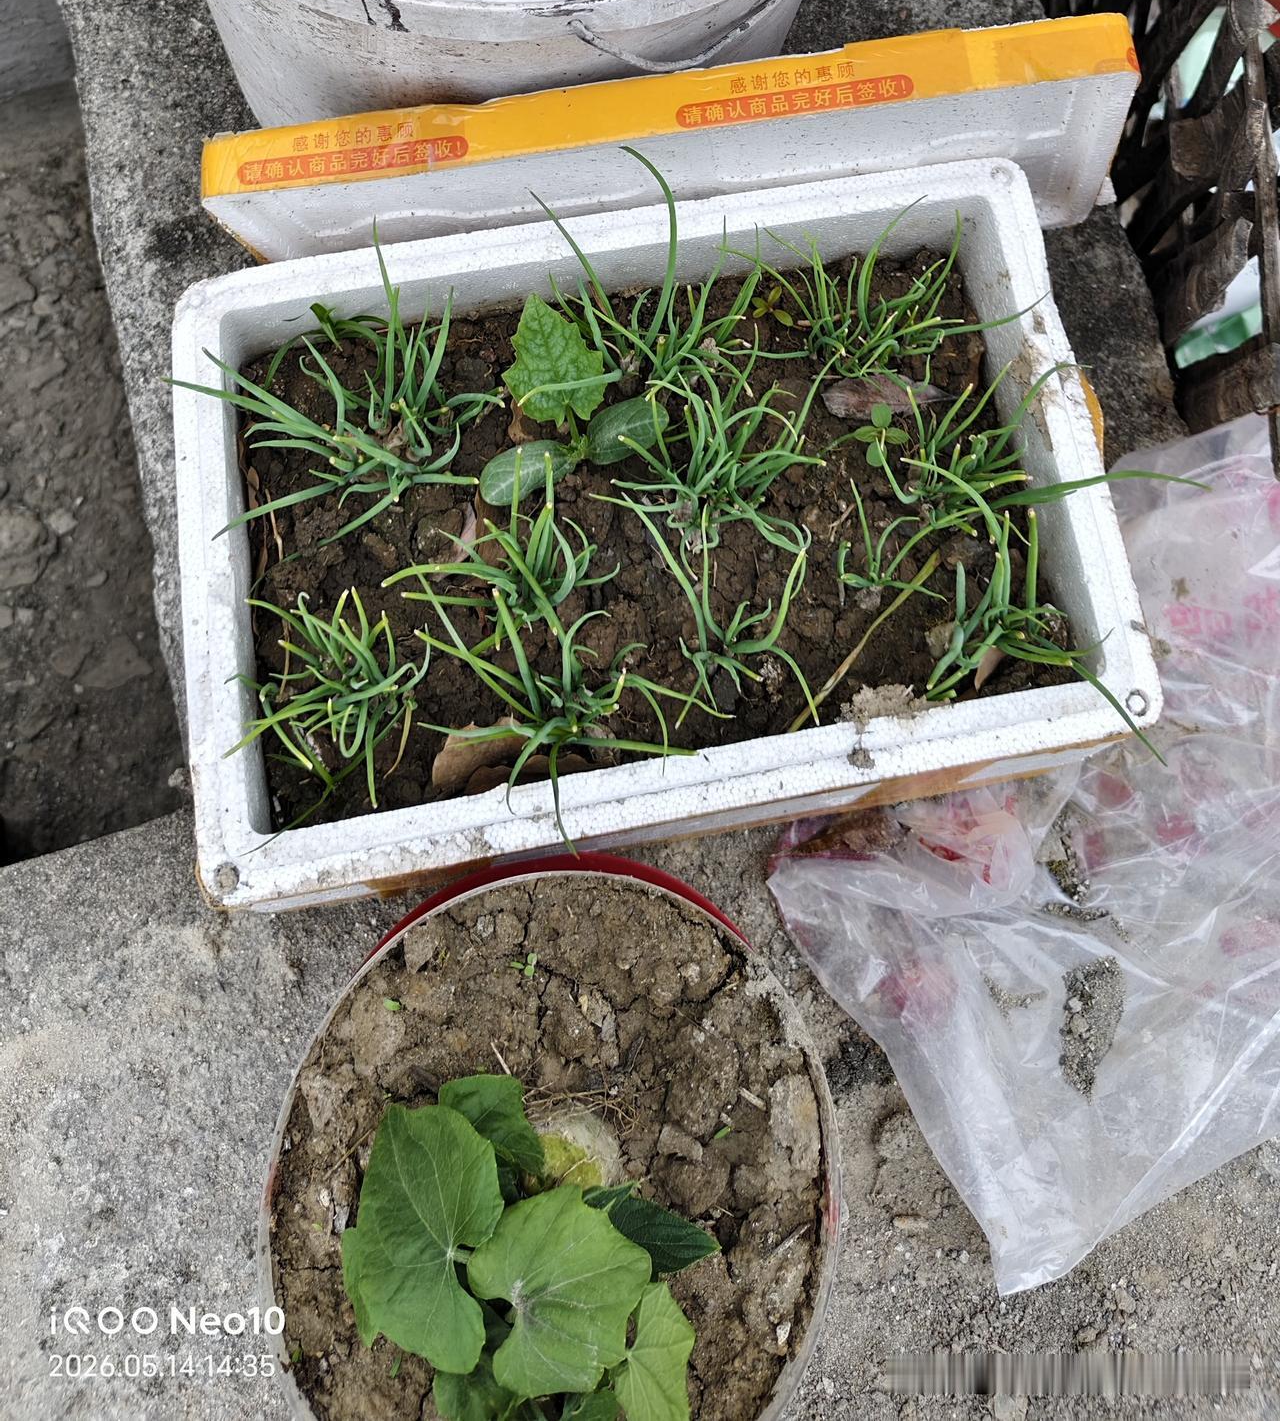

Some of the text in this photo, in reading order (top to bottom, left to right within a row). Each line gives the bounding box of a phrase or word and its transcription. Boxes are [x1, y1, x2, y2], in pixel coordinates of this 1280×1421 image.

[729, 61, 856, 95] 感谢您的惠顾
[682, 79, 908, 125] 请确认商品完好后签收！
[292, 121, 415, 152] 感谢您的惠顾
[244, 140, 463, 182] 请确认商品完好后签收！
